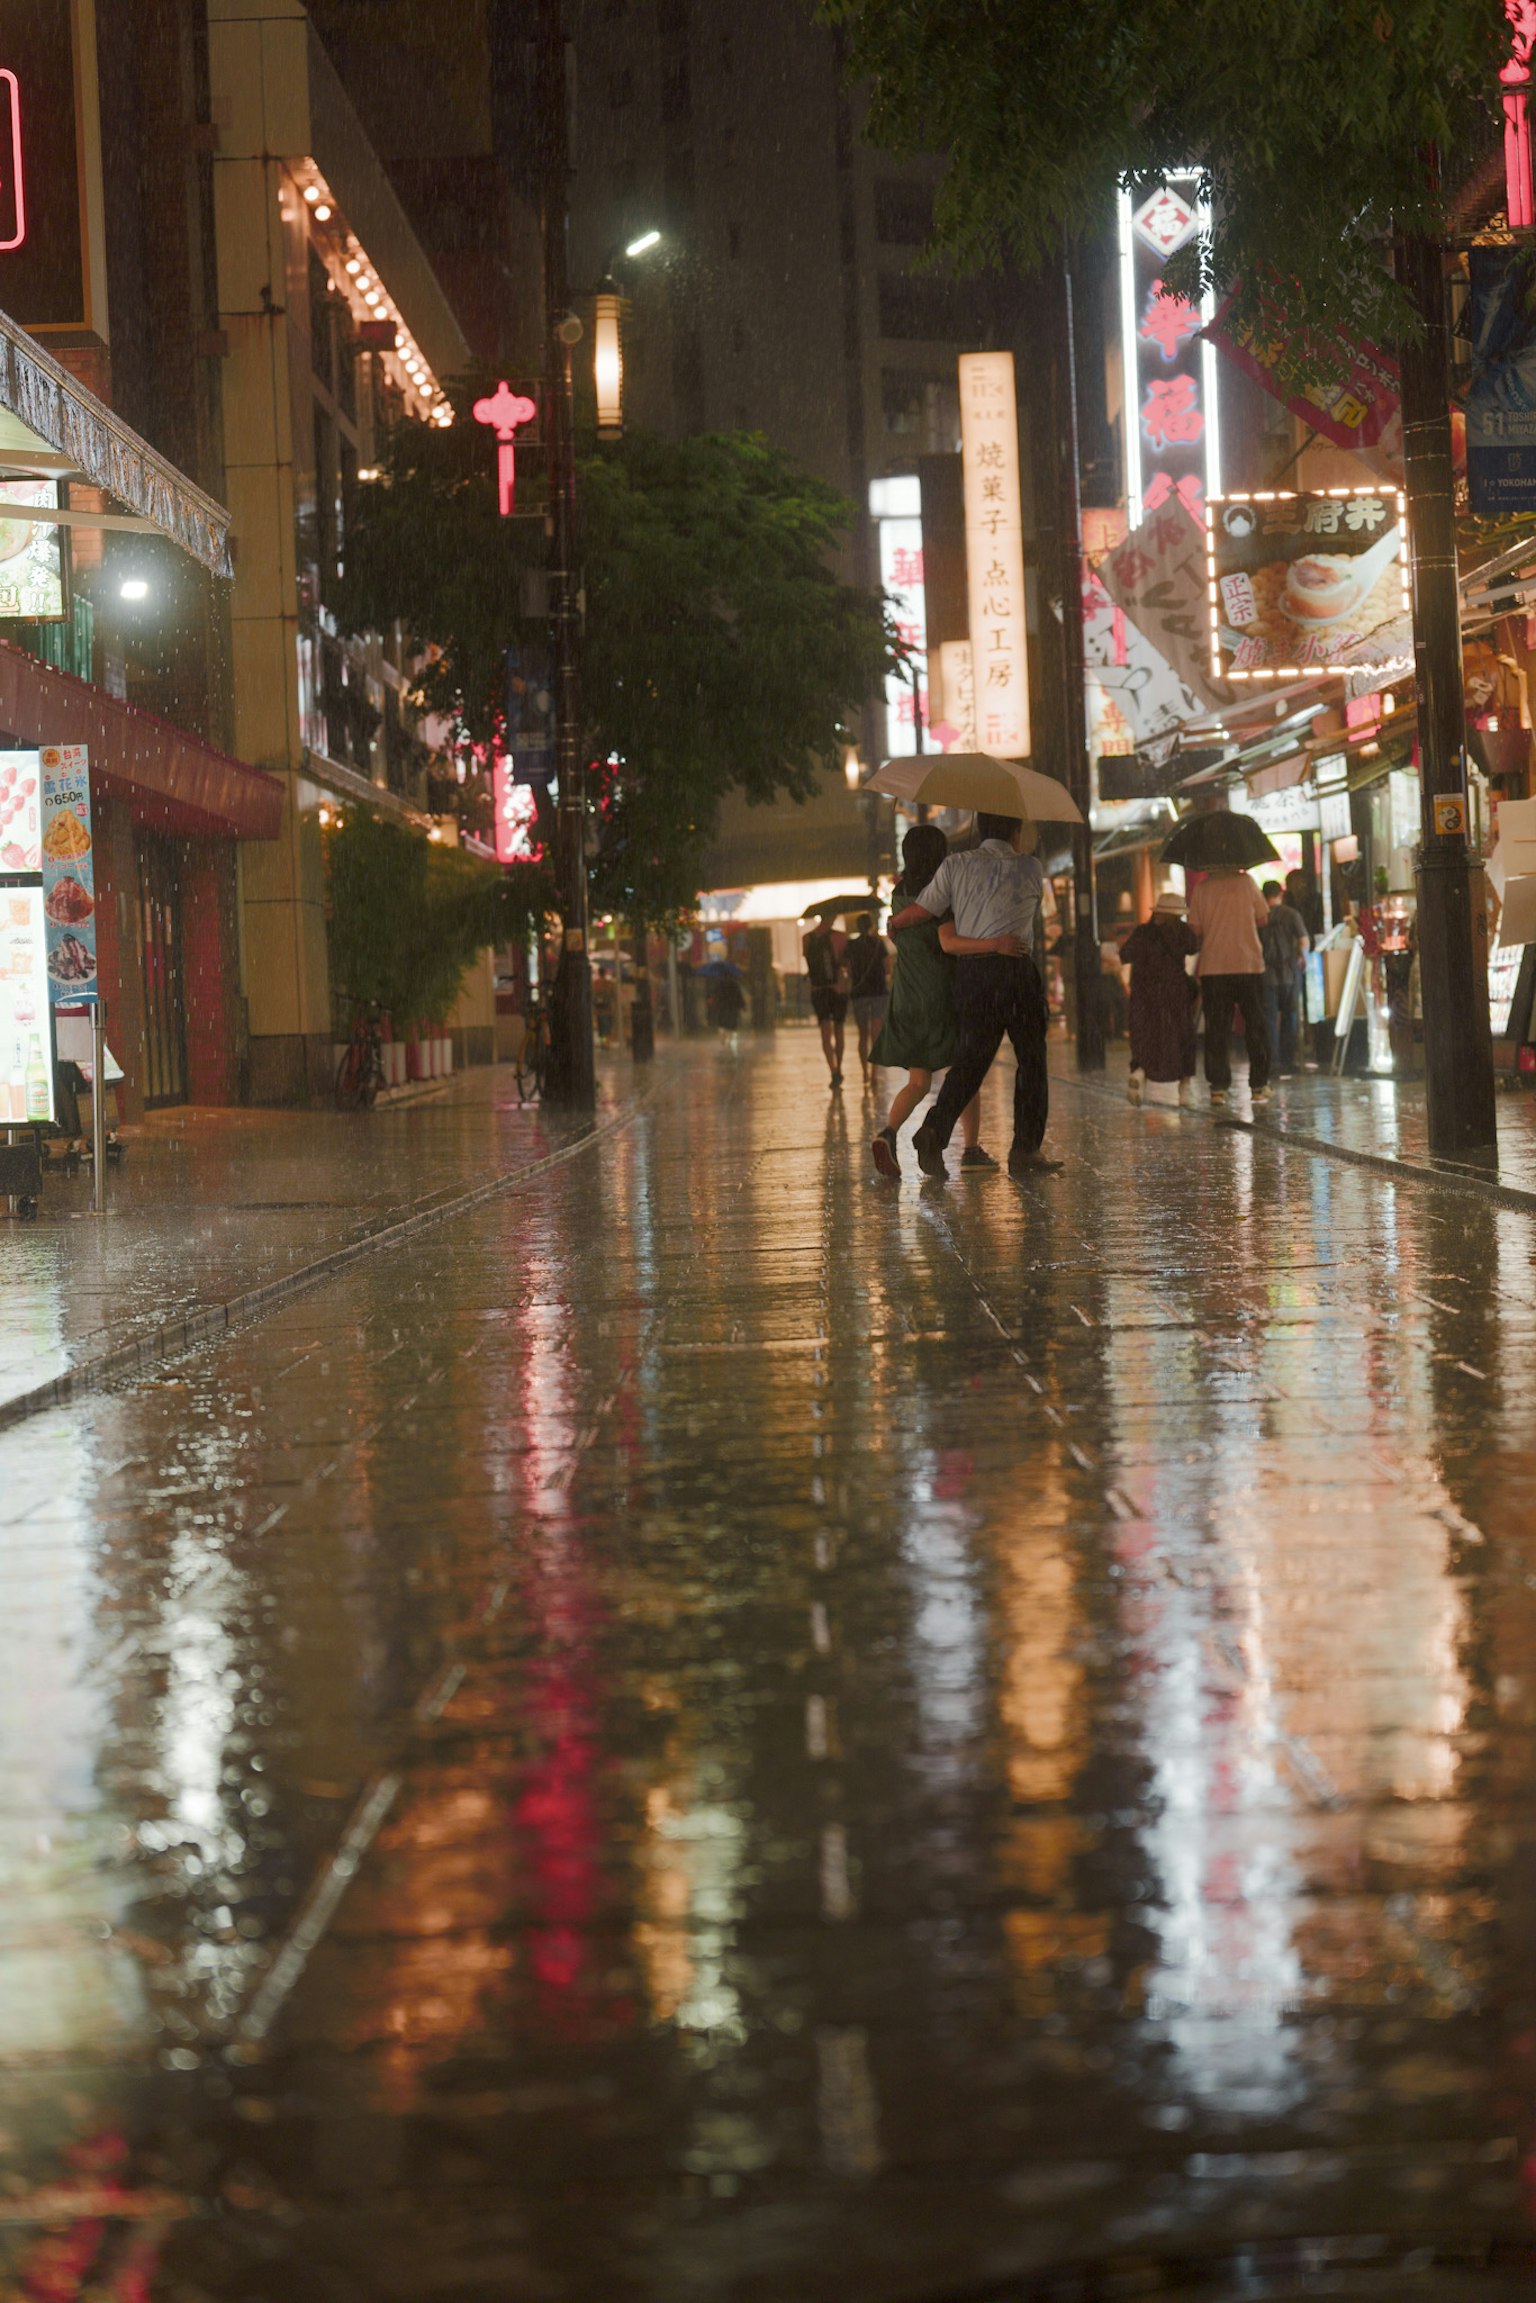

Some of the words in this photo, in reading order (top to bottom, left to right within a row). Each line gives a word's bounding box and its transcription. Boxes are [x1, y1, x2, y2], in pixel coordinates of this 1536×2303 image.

[1262, 496, 1387, 535] 王府井
[1226, 576, 1253, 622] 正宗
